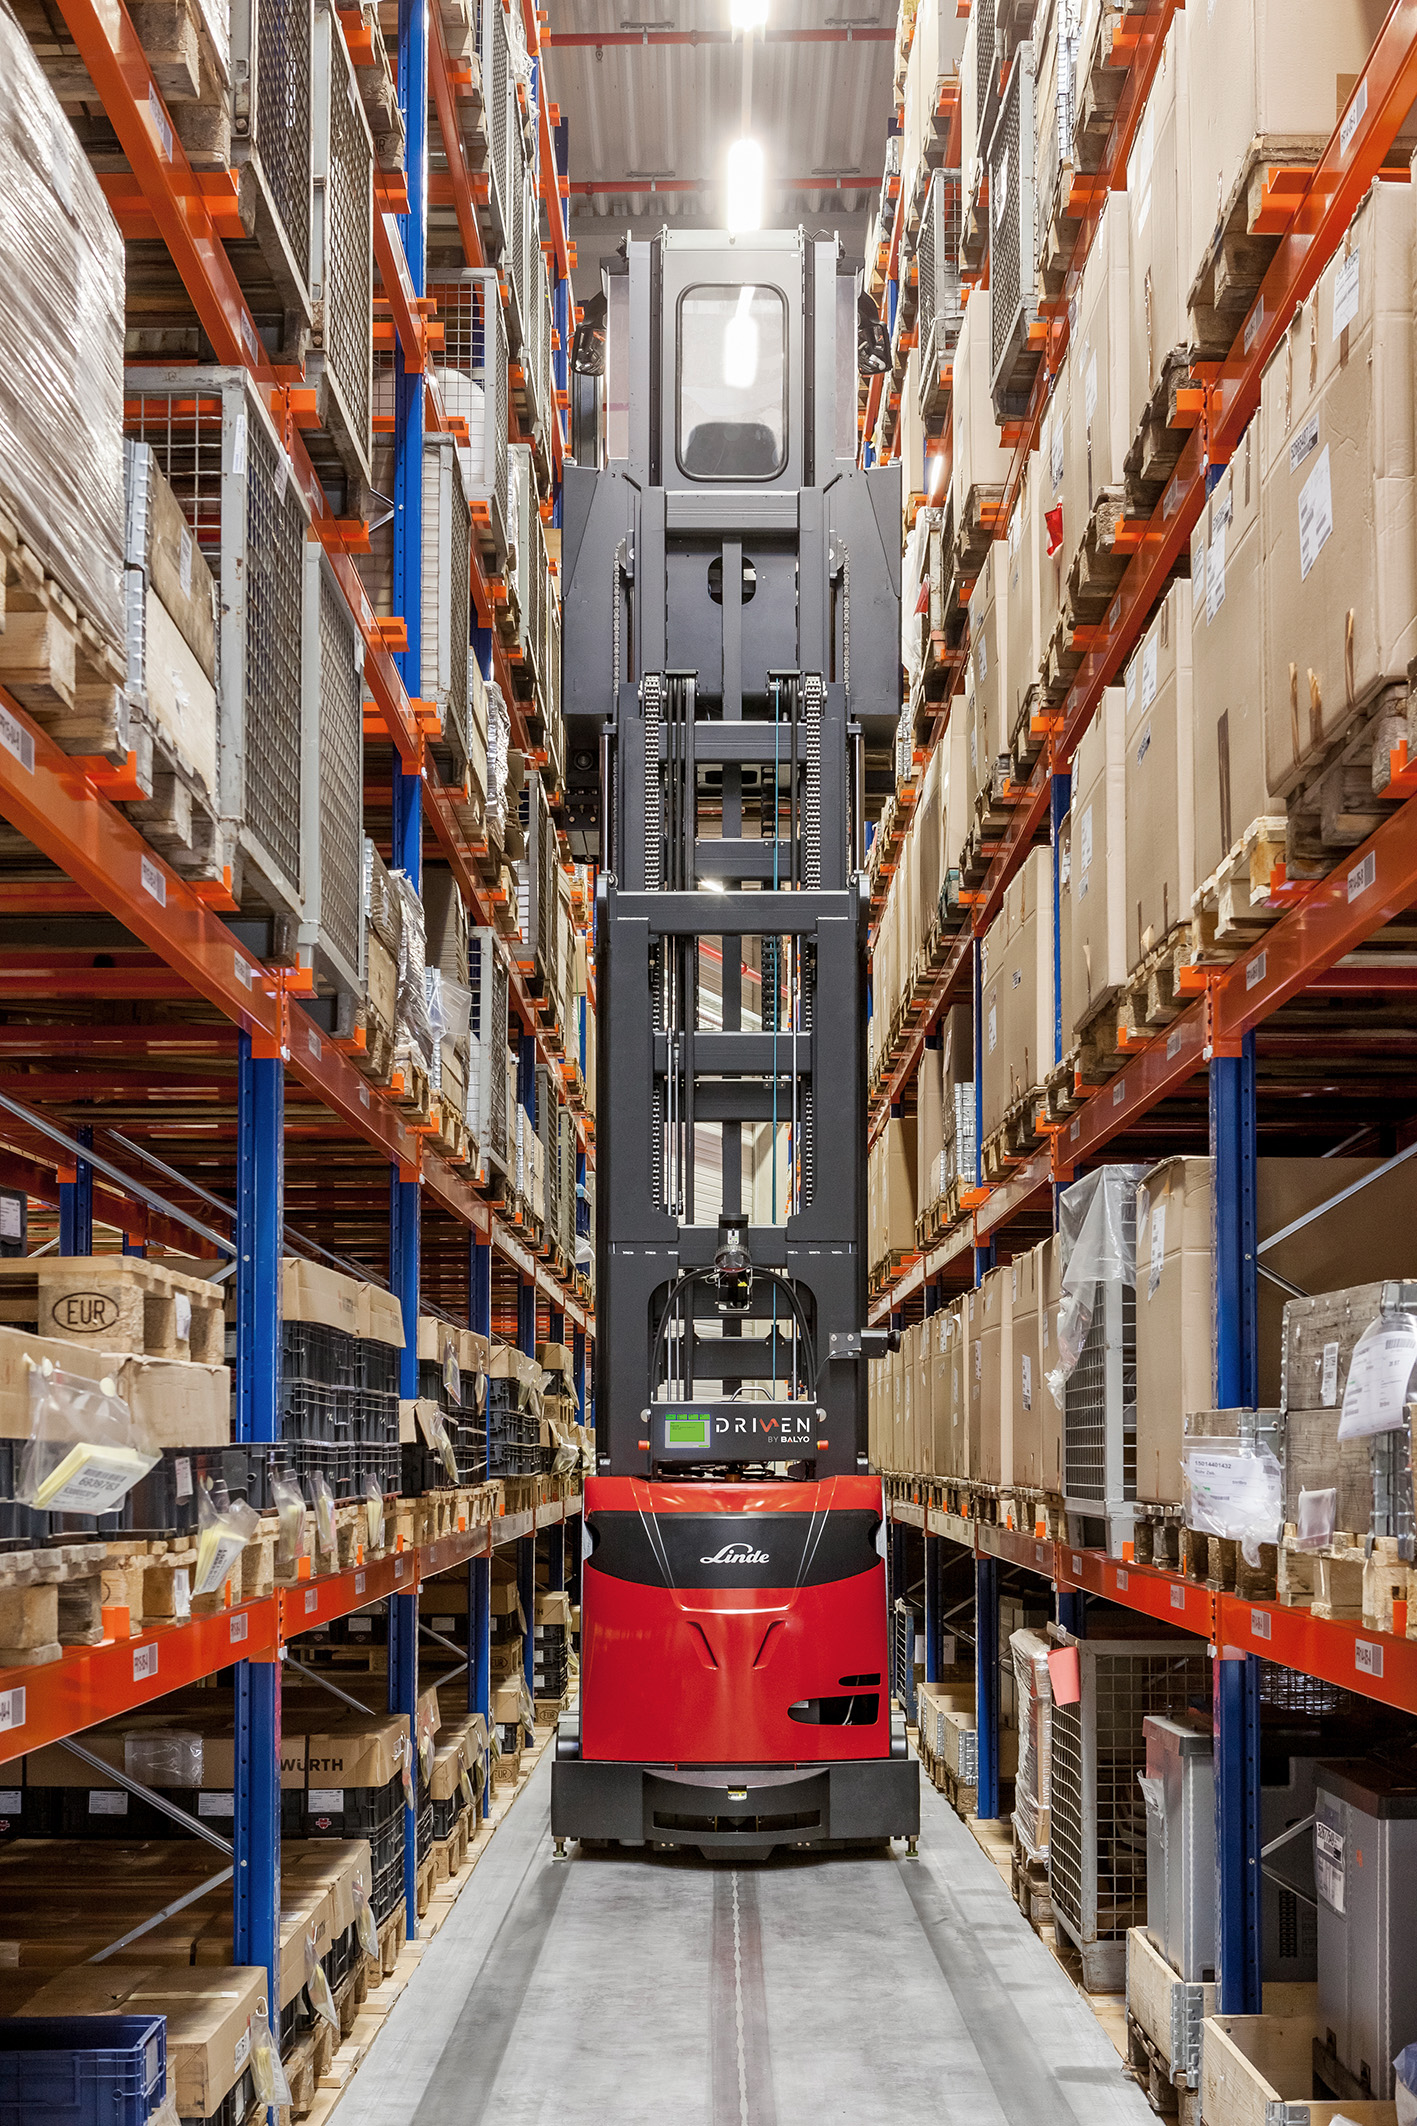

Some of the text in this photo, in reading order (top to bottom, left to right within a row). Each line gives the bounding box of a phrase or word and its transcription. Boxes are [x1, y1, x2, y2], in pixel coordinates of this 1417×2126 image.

[67, 1300, 106, 1325] EUR
[716, 1417, 810, 1433] DRIVEN
[78, 1477, 121, 1491] 6939763
[700, 1543, 770, 1564] Linde
